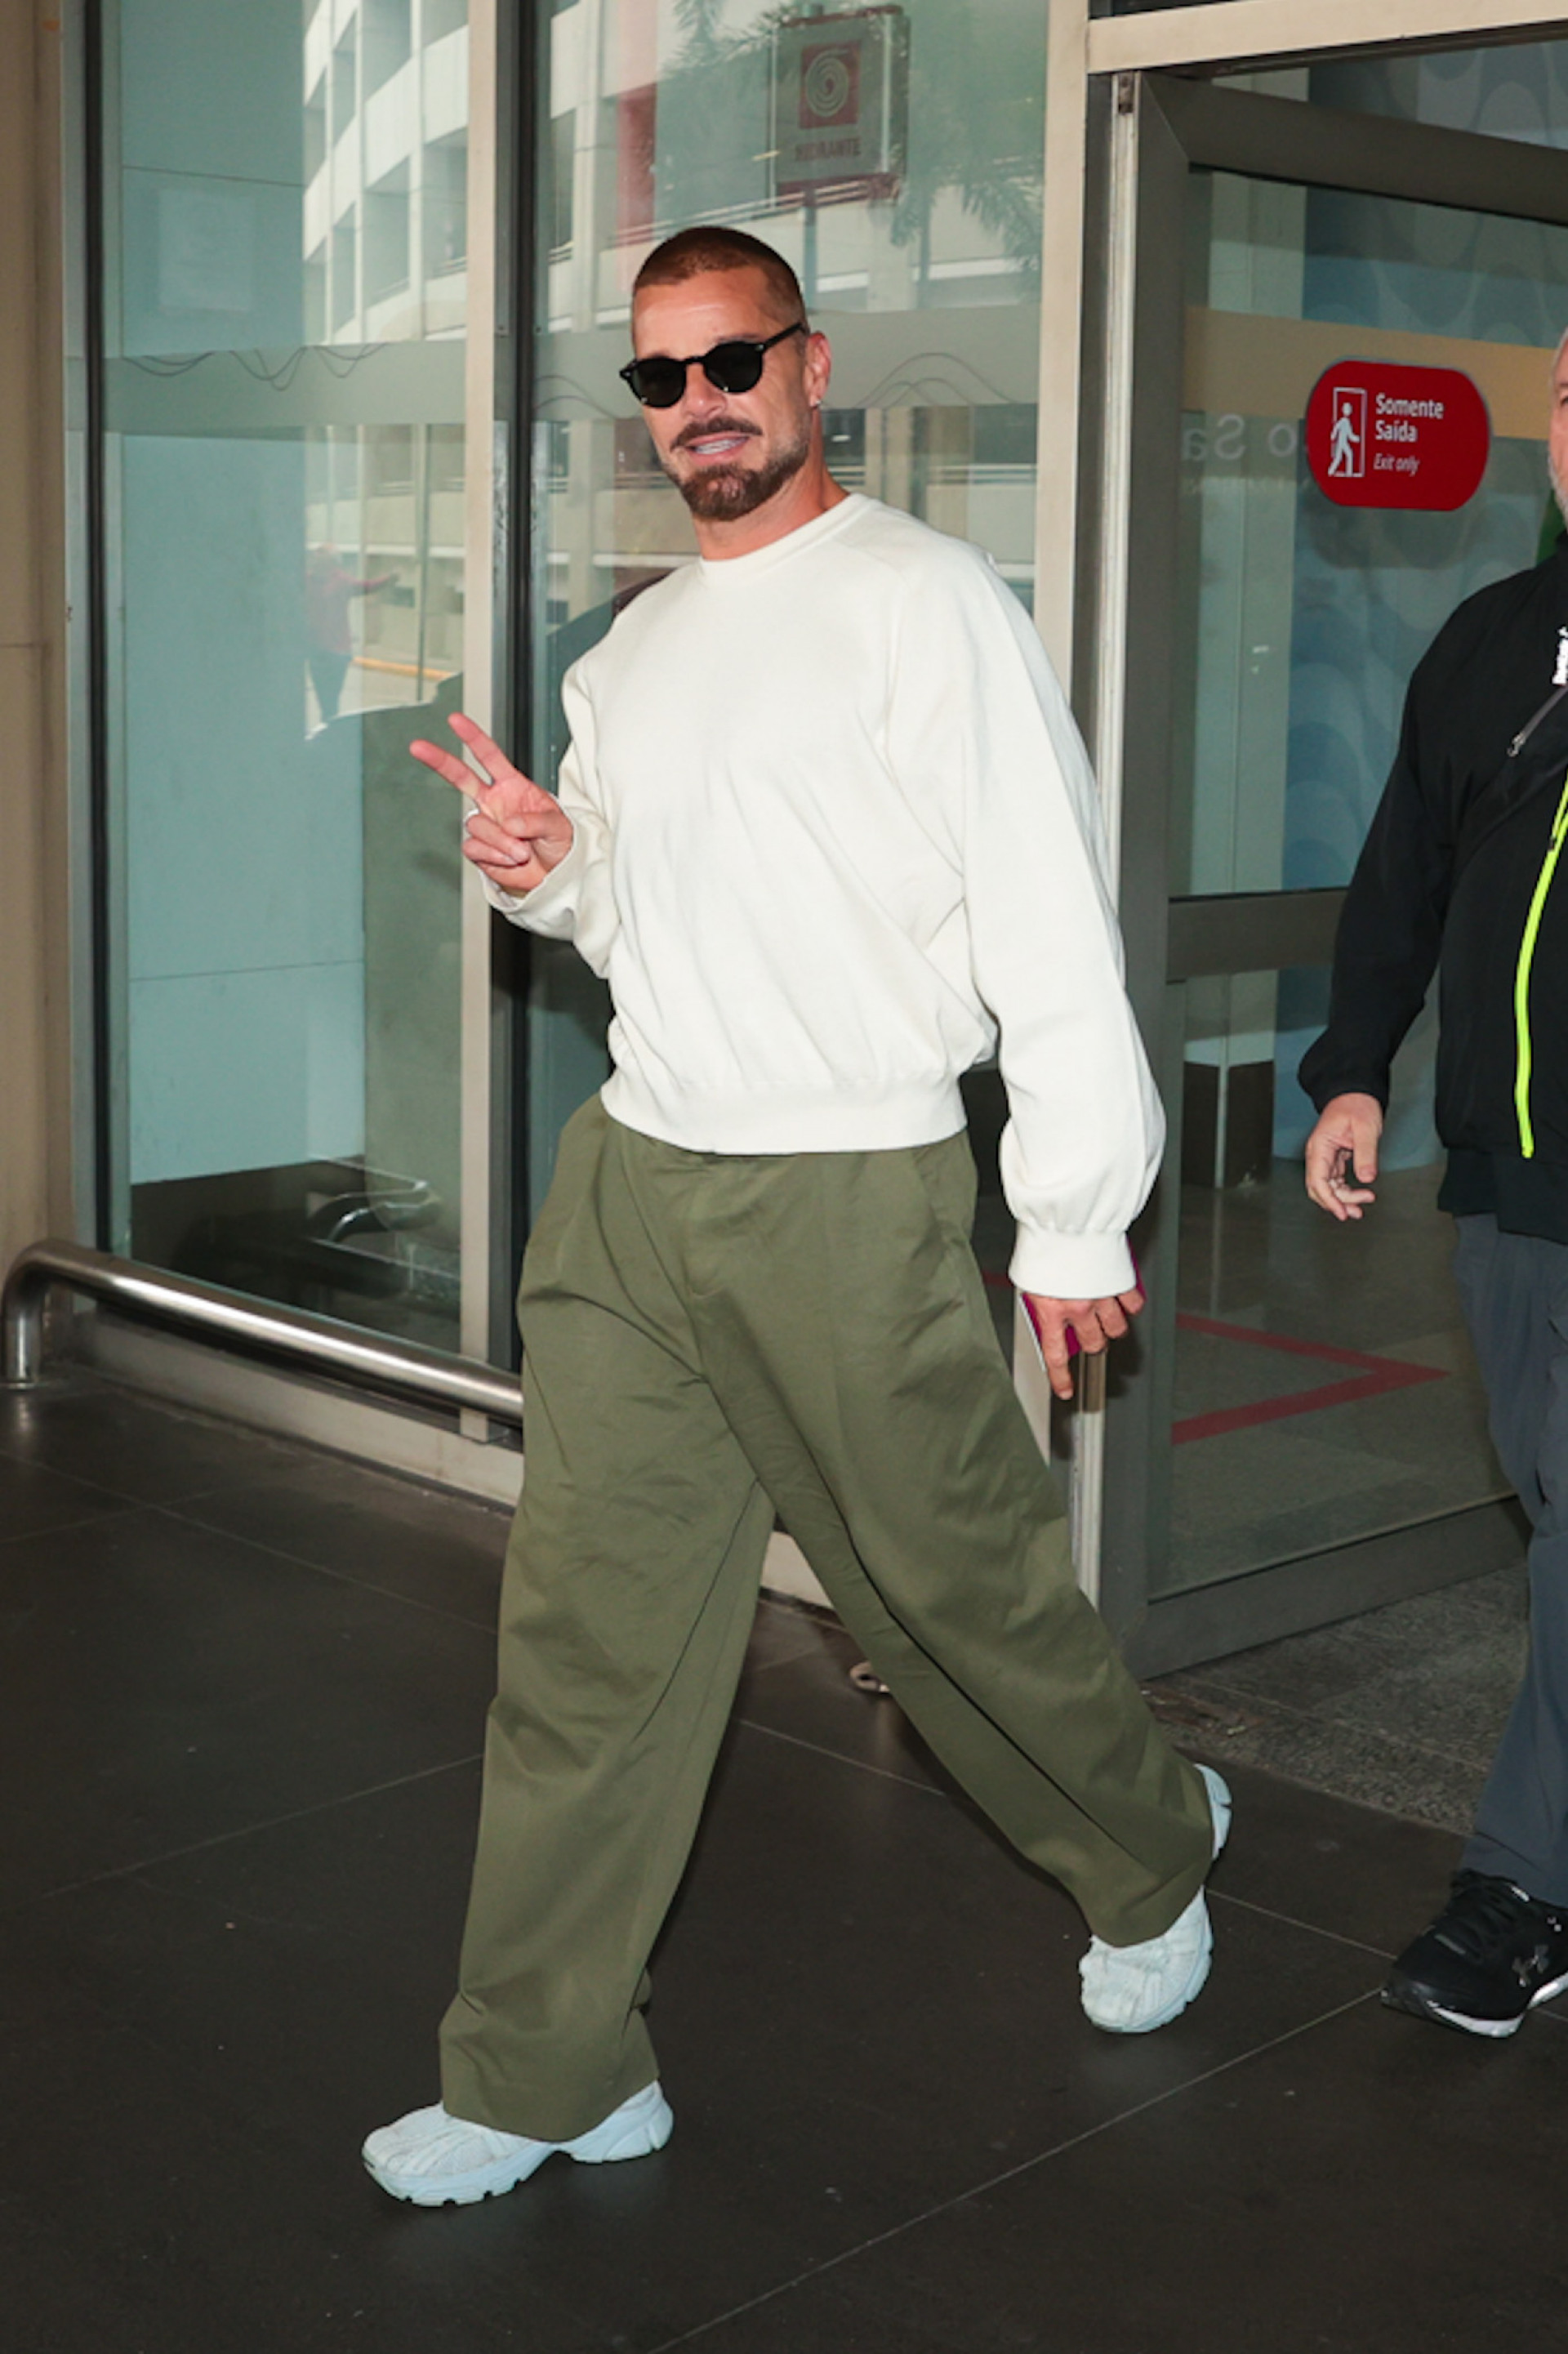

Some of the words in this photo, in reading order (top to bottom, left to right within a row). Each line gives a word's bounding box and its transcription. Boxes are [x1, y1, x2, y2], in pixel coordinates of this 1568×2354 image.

[1376, 392, 1444, 420] Somente
[1375, 419, 1418, 443] Saída
[1374, 453, 1395, 471] Exit
[1396, 456, 1420, 477] only
